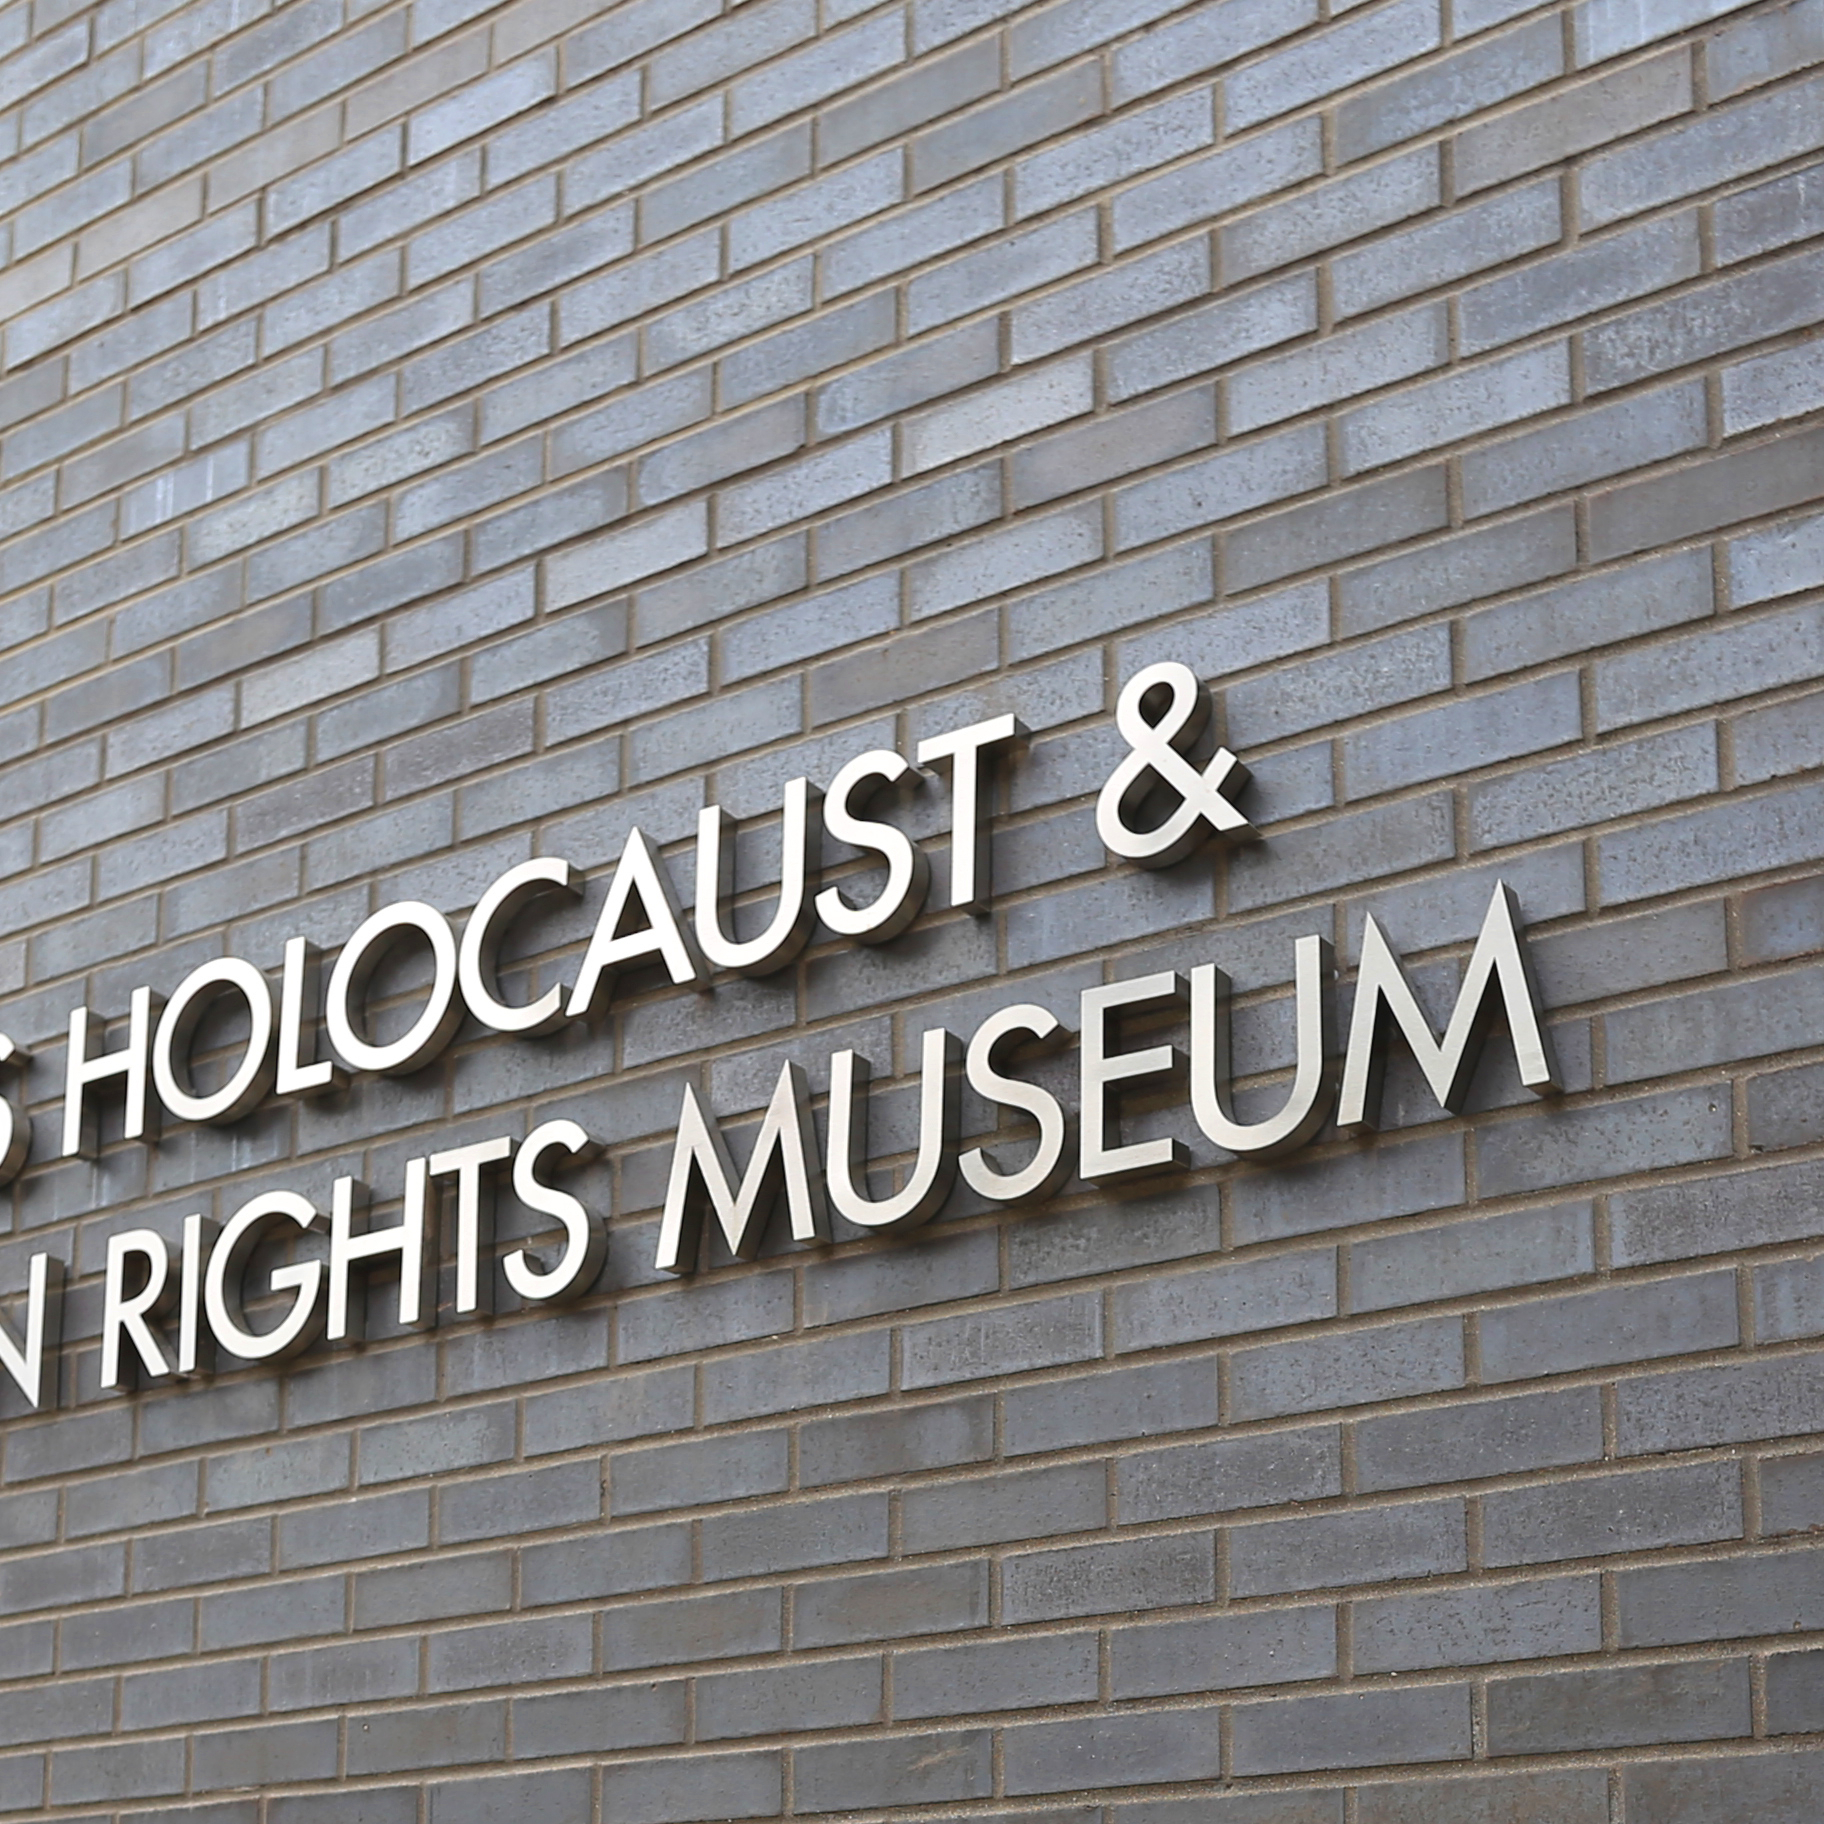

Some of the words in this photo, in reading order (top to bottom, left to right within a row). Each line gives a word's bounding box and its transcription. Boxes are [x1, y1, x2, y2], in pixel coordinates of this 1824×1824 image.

[61, 713, 1026, 1158] HOLOCAUST
[1094, 660, 1254, 860] &
[98, 1118, 604, 1392] RIGHTS
[656, 882, 1558, 1275] MUSEUM
